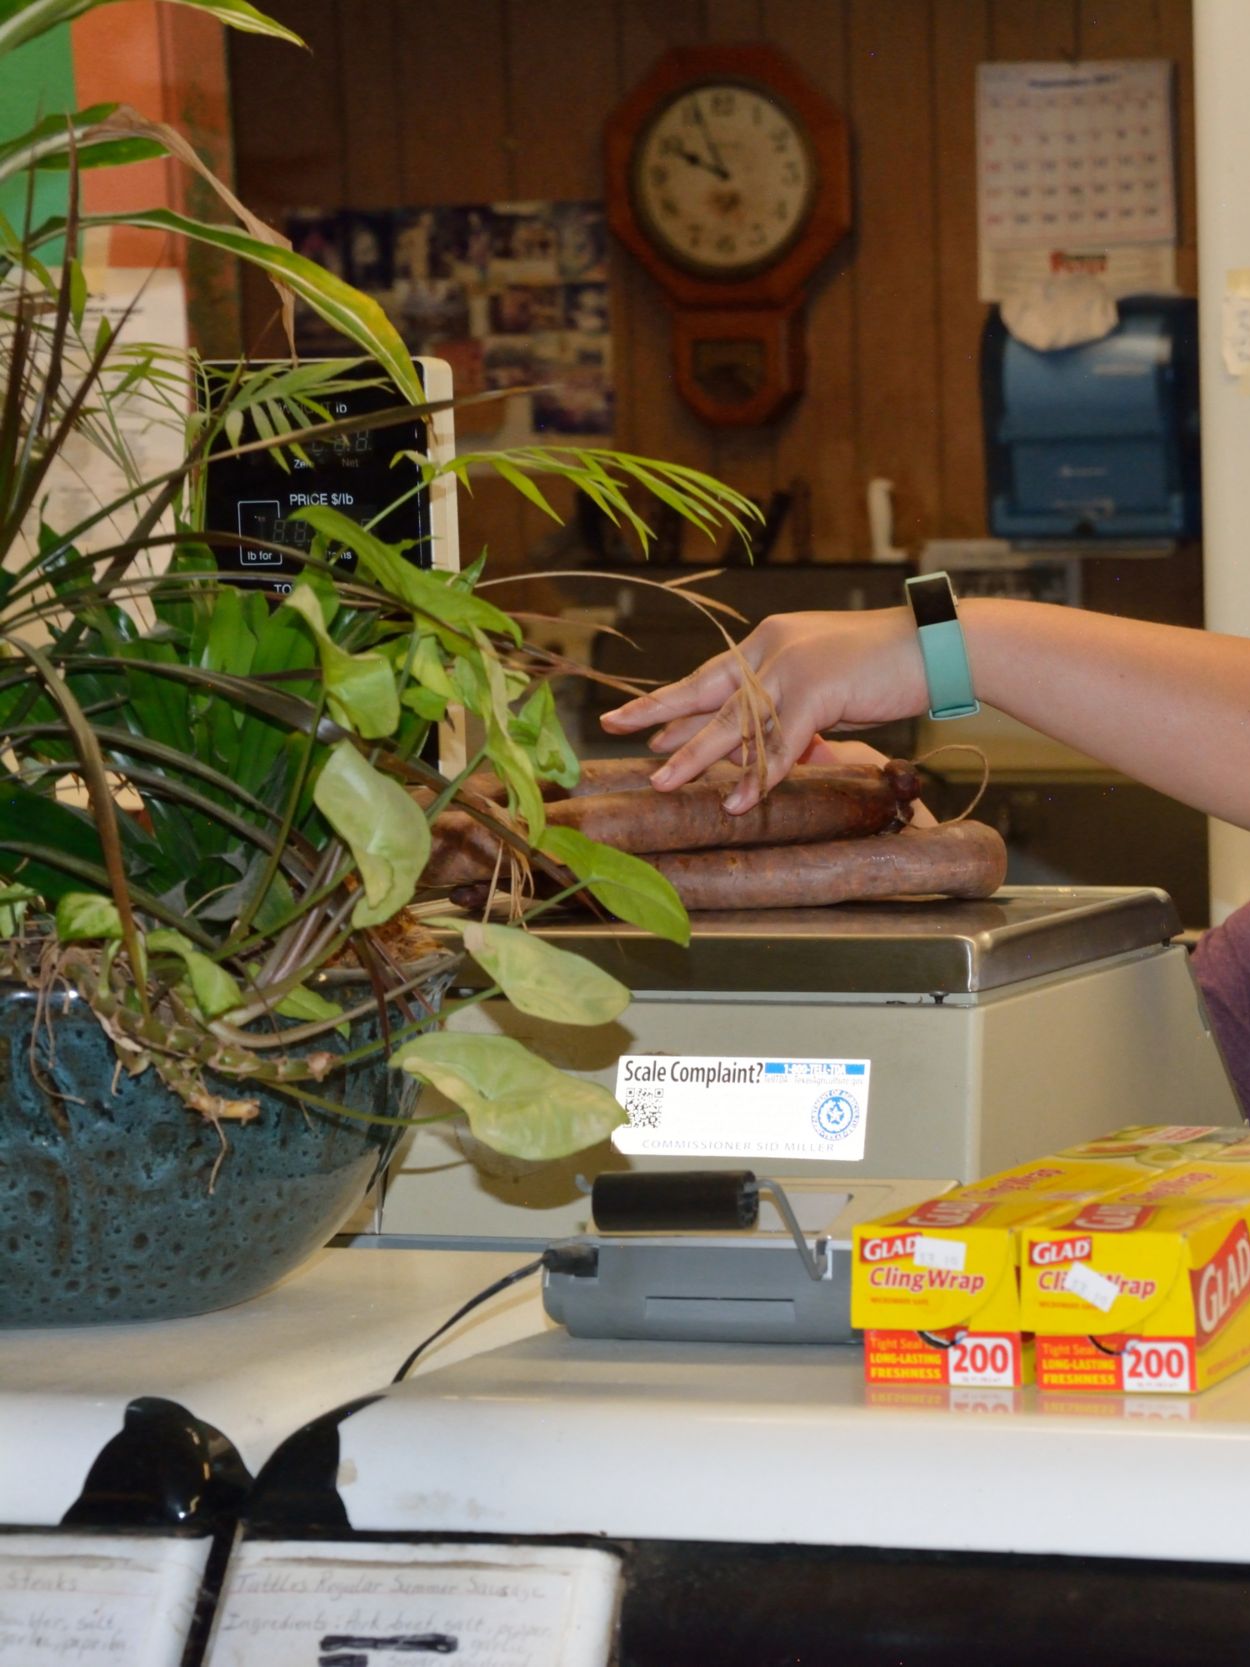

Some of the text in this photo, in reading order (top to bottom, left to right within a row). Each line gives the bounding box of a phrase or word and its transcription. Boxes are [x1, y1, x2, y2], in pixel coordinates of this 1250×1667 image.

[289, 492, 354, 506] PRICE $/lb
[247, 551, 273, 560] lb for
[624, 1060, 763, 1088] Scale Complaint?
[641, 1139, 835, 1153] COMMISSIONER SID MILLER
[1031, 1238, 1091, 1265] GLAD
[870, 1353, 942, 1365] LONG-LASTING
[953, 1343, 1009, 1374] 200
[1041, 1358, 1116, 1371] LONG-LASTING
[1127, 1348, 1185, 1379] 200
[870, 1367, 941, 1379] FRESHNESS
[1043, 1373, 1116, 1385] FRESHNESS
[314, 1571, 384, 1601] Regular
[388, 1574, 460, 1596] Summer
[466, 1575, 546, 1602] Sausage
